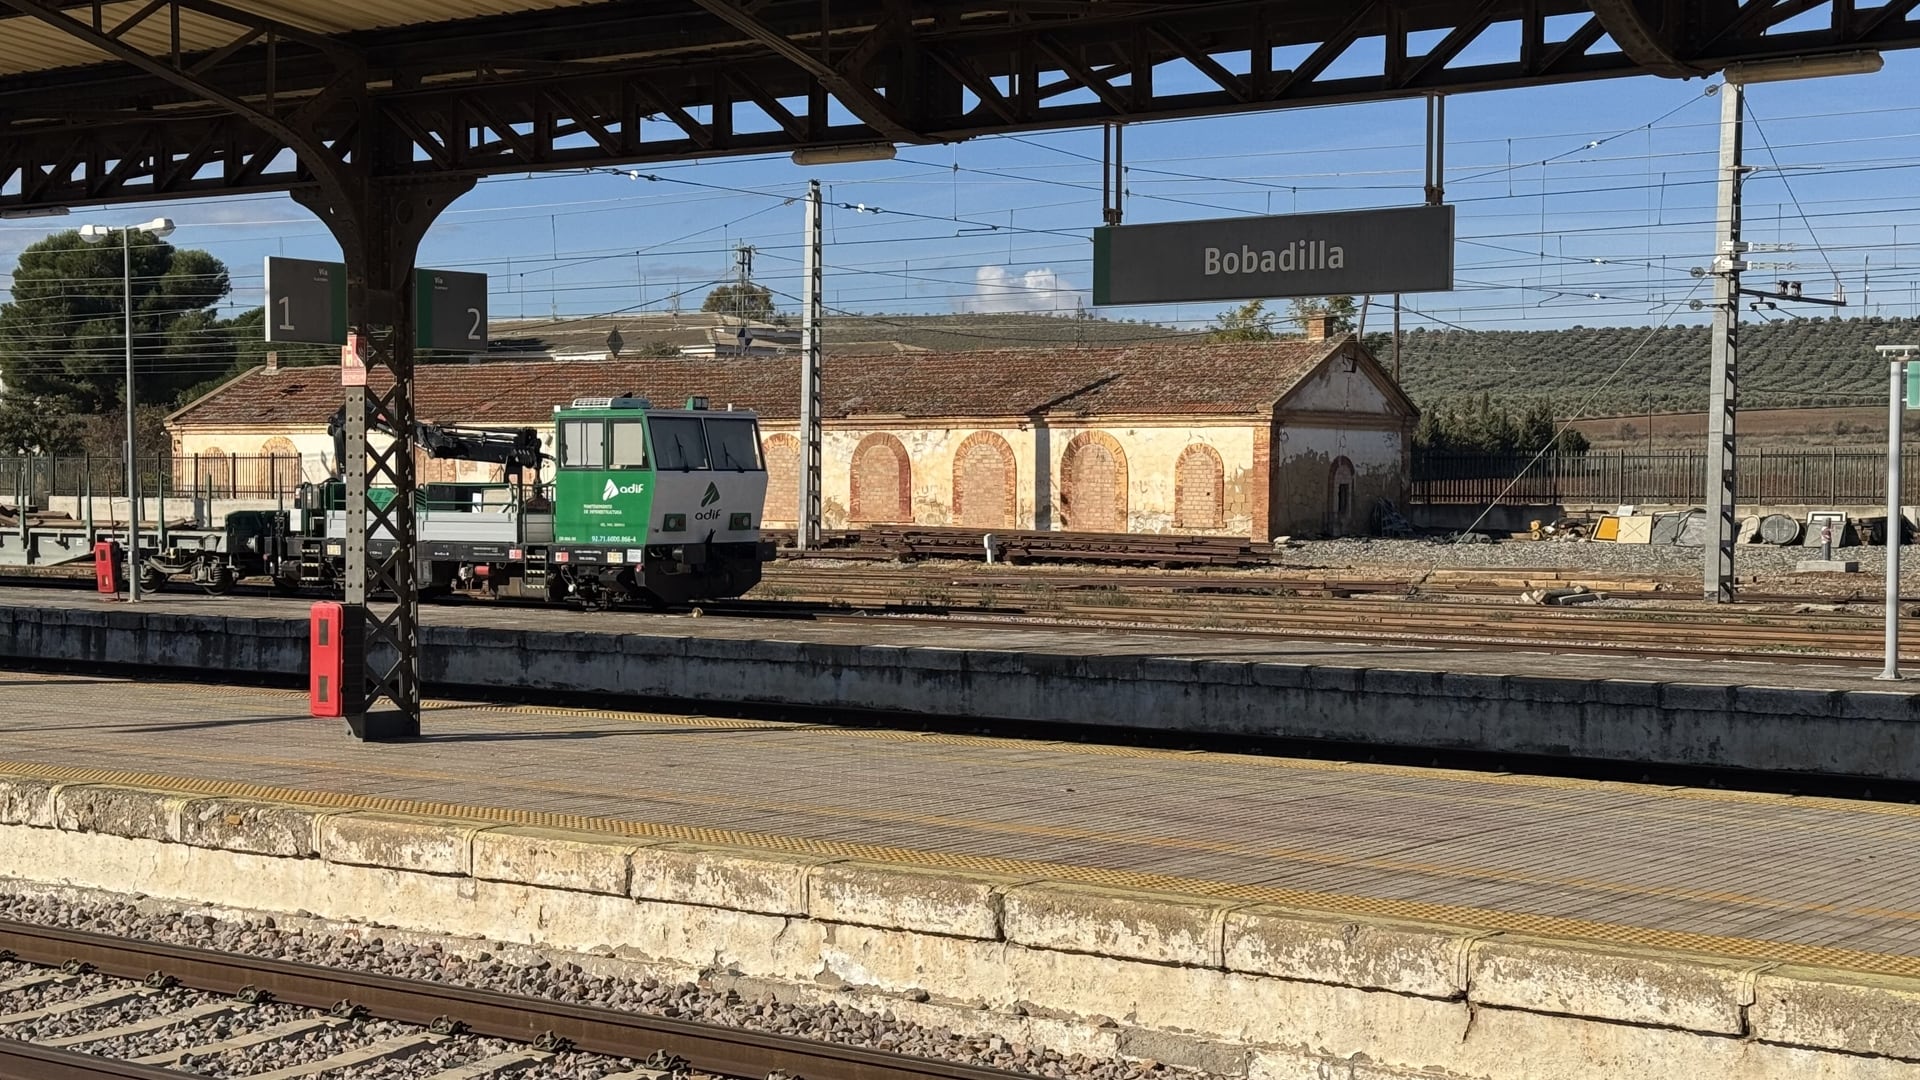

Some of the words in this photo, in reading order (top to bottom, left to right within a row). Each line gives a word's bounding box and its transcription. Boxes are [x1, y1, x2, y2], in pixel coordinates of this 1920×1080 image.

[1204, 239, 1345, 276] Bobadilla
[278, 296, 295, 331] 1
[467, 308, 481, 340] 2
[620, 483, 644, 494] adif
[695, 509, 721, 520] adif
